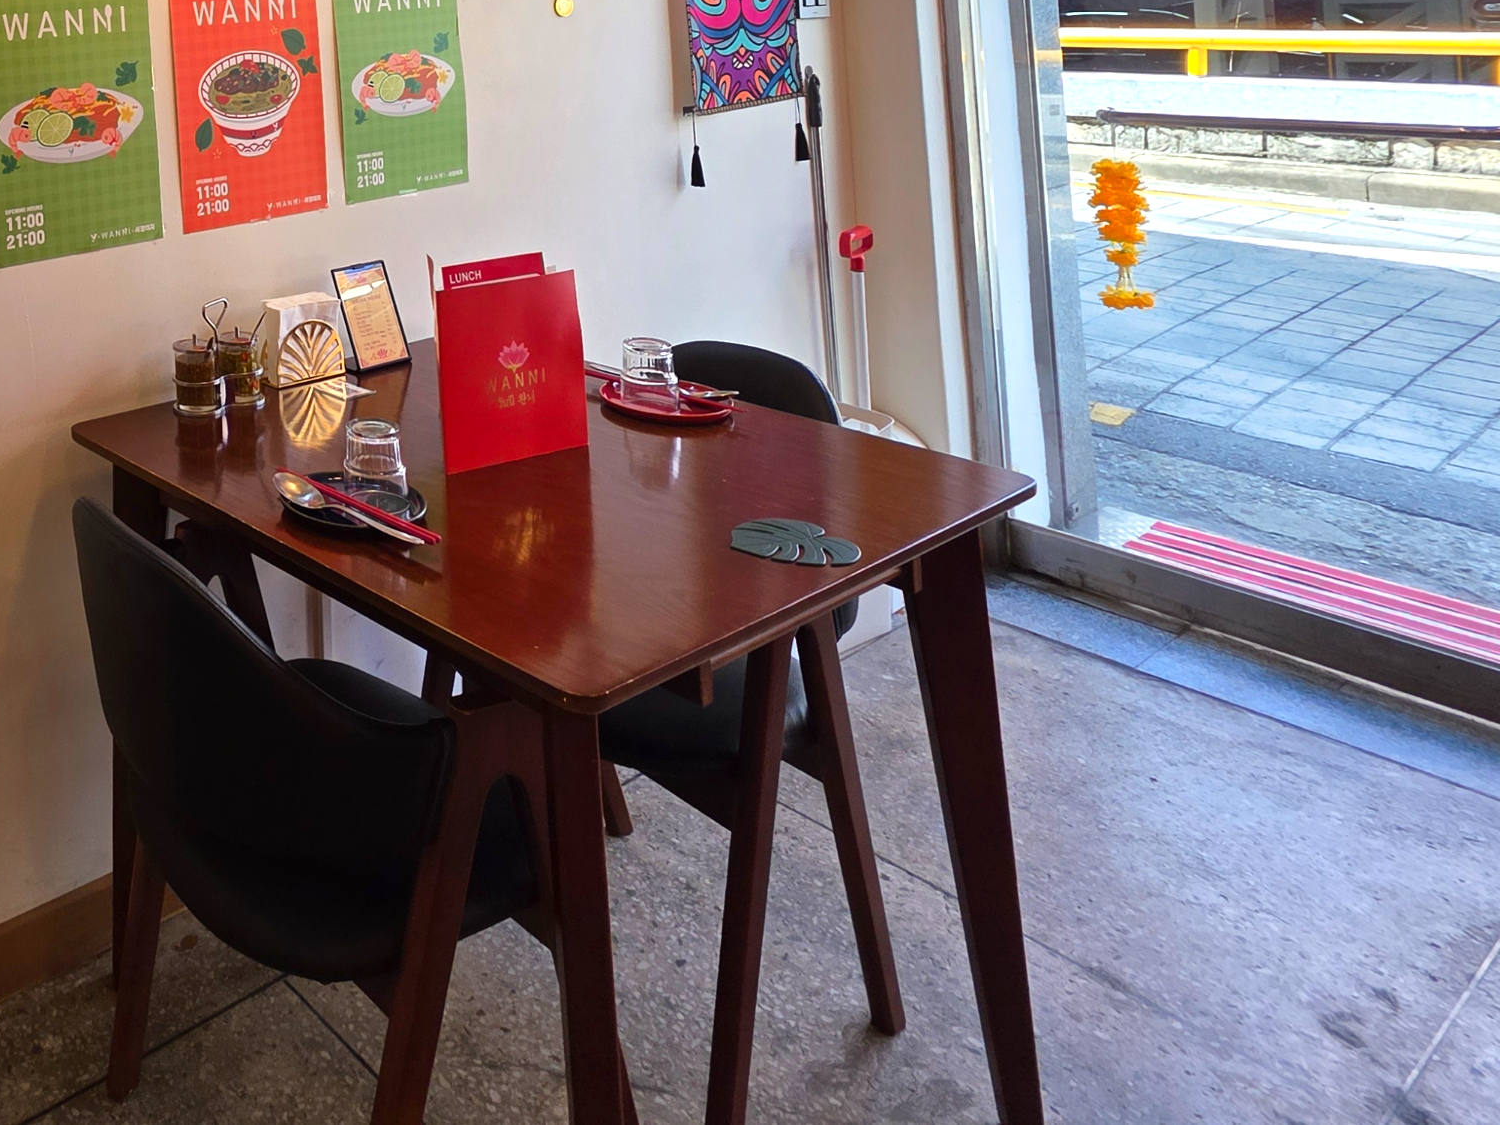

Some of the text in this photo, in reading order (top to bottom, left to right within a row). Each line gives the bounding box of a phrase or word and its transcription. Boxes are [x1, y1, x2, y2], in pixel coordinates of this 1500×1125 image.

[2, 4, 126, 41] WANNI
[357, 158, 384, 173] 11:00
[357, 172, 384, 188] 21:00
[196, 183, 228, 199] 11:00
[197, 199, 230, 216] 21:00
[6, 212, 44, 231] 11:00
[6, 230, 45, 250] 21:00
[101, 227, 131, 239] WANNI
[449, 270, 482, 284] LUNCH
[485, 367, 546, 393] WANNI
